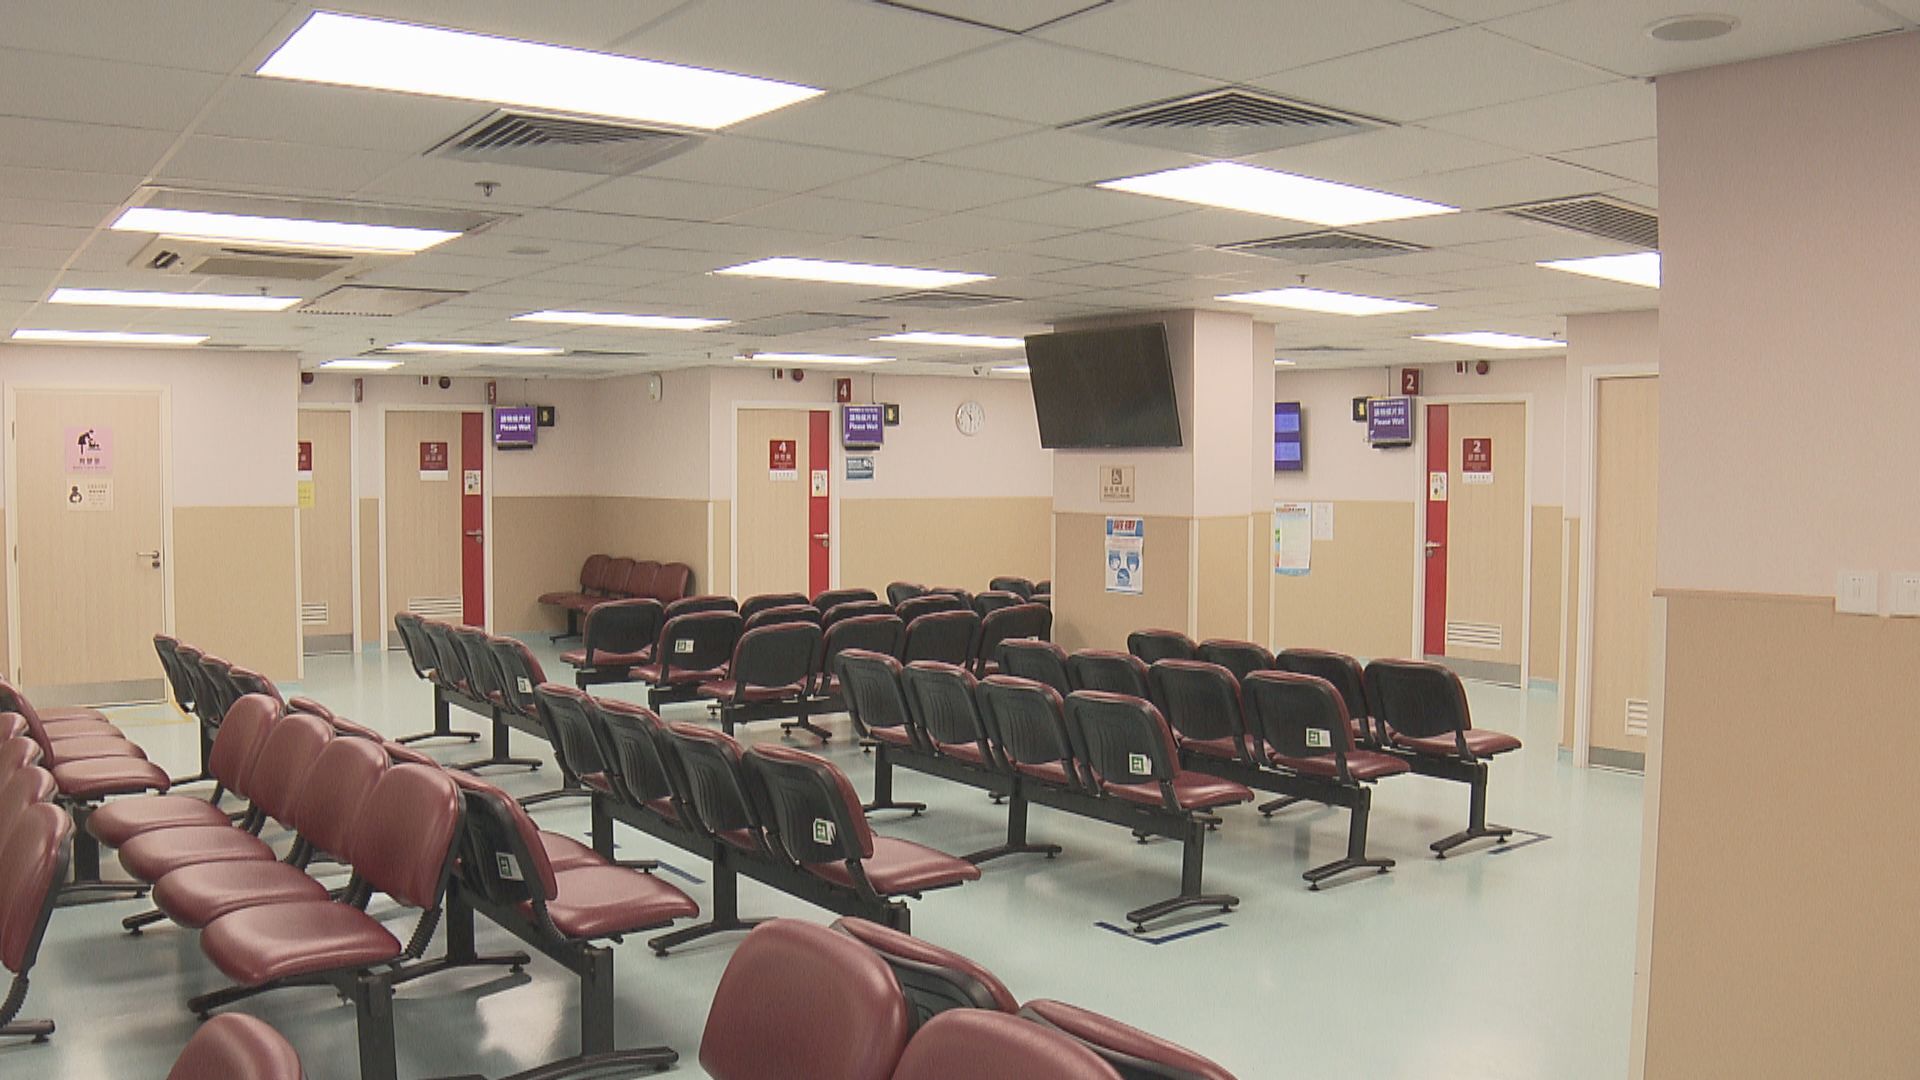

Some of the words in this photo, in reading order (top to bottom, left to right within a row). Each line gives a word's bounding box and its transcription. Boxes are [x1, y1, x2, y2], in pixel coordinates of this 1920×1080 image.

[1406, 374, 1414, 391] 2
[840, 383, 848, 398] 4
[849, 423, 866, 431] Please
[866, 423, 879, 431] Wait
[1373, 418, 1391, 426] Please
[500, 424, 517, 432] Please
[518, 424, 531, 432] Wait
[429, 443, 438, 454] 5
[779, 441, 787, 453] 4
[1473, 440, 1481, 453] 2
